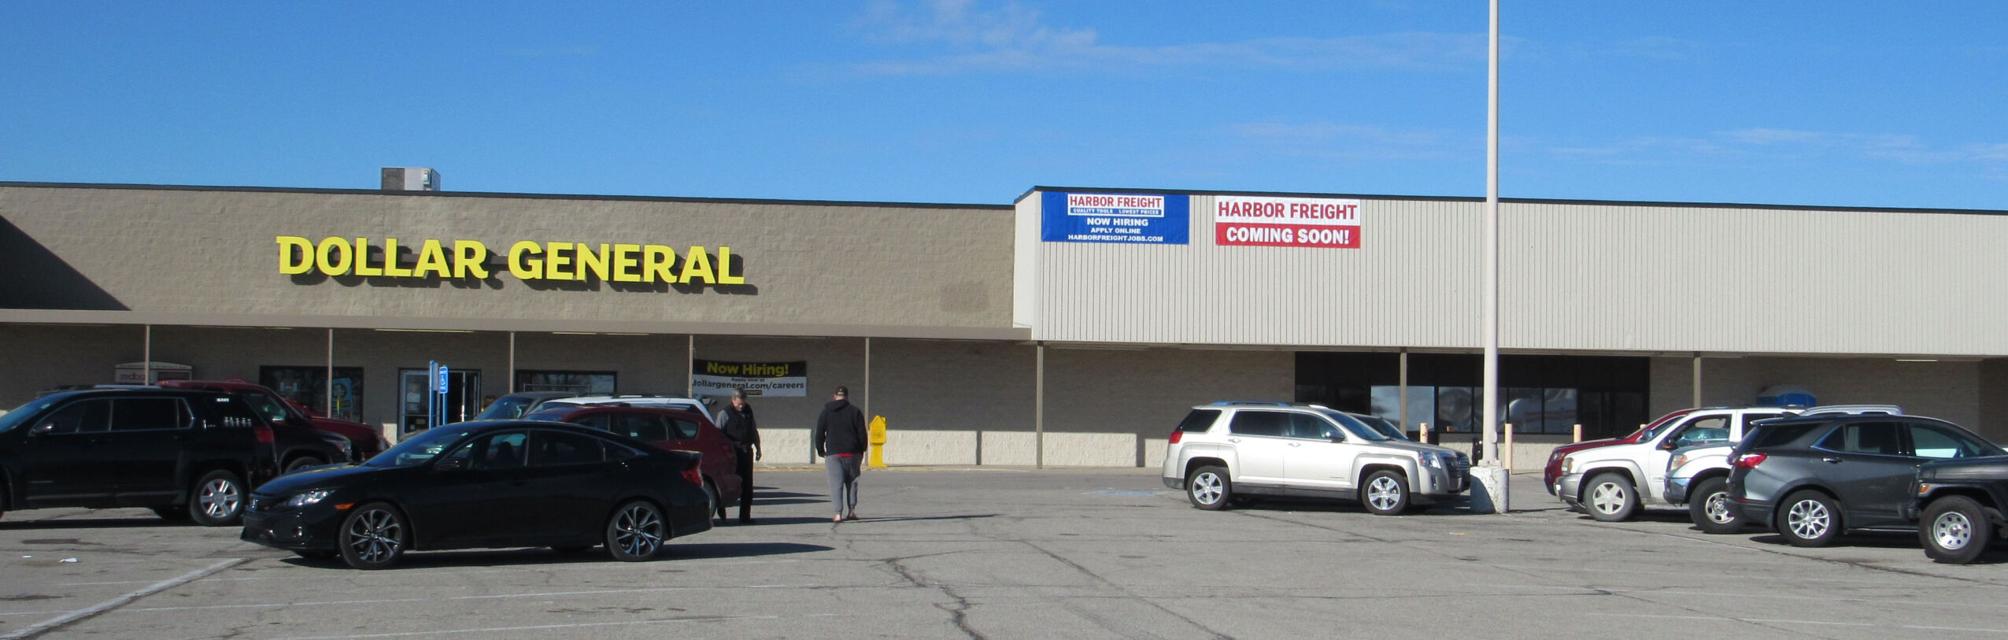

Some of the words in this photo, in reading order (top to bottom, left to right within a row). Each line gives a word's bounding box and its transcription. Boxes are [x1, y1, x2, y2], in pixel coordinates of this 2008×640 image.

[1070, 196, 1114, 206] HARBOR
[1117, 197, 1162, 208] FREIGHT
[1218, 201, 1285, 218] HARBOR
[1290, 203, 1357, 220] FREIGHT
[1086, 218, 1110, 226] NOW
[1113, 218, 1149, 226] HIRING
[1068, 234, 1164, 242] HARBORFREIGHTJOBS.COM
[1226, 226, 1293, 243] COMING
[1298, 228, 1350, 245] SOON!
[276, 236, 489, 278] DOLLAR
[507, 240, 745, 285] GENERAL
[707, 362, 739, 374] Now
[742, 363, 789, 376] Hiring!
